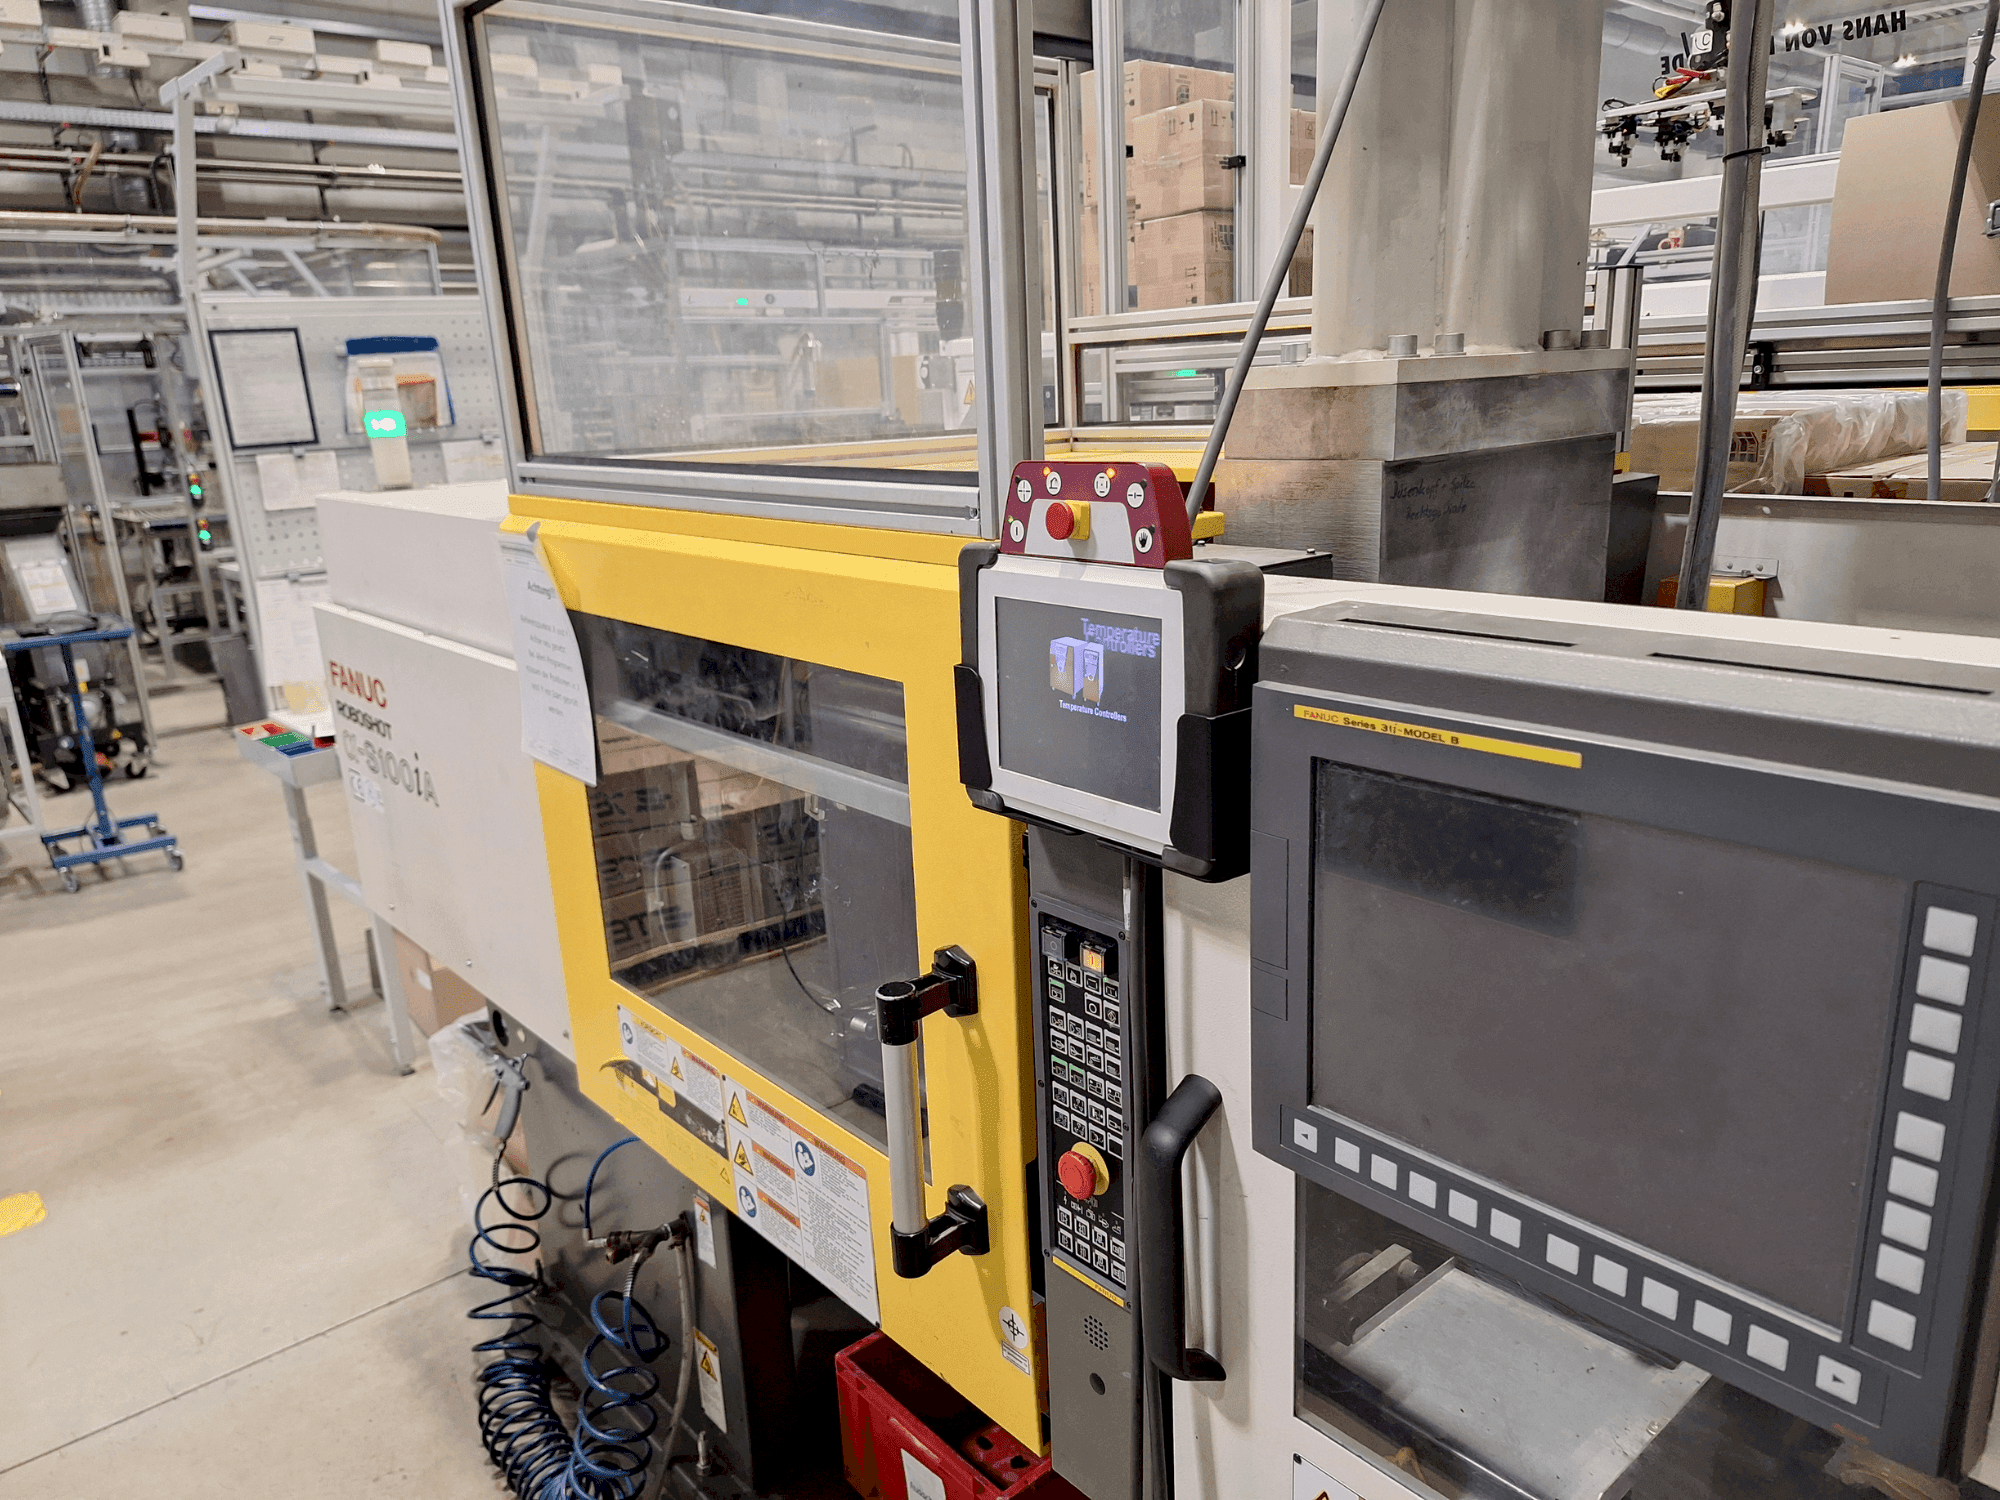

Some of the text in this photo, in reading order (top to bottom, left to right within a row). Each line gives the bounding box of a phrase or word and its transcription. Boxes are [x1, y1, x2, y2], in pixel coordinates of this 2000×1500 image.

[1081, 617, 1160, 646] Temperature
[329, 660, 388, 709] FANUC
[336, 699, 392, 741] ROBOSHOT
[1059, 699, 1127, 722] Temperature Controllers
[1303, 709, 1339, 723] FANUC
[1342, 717, 1376, 731] Series
[1450, 735, 1460, 745] B
